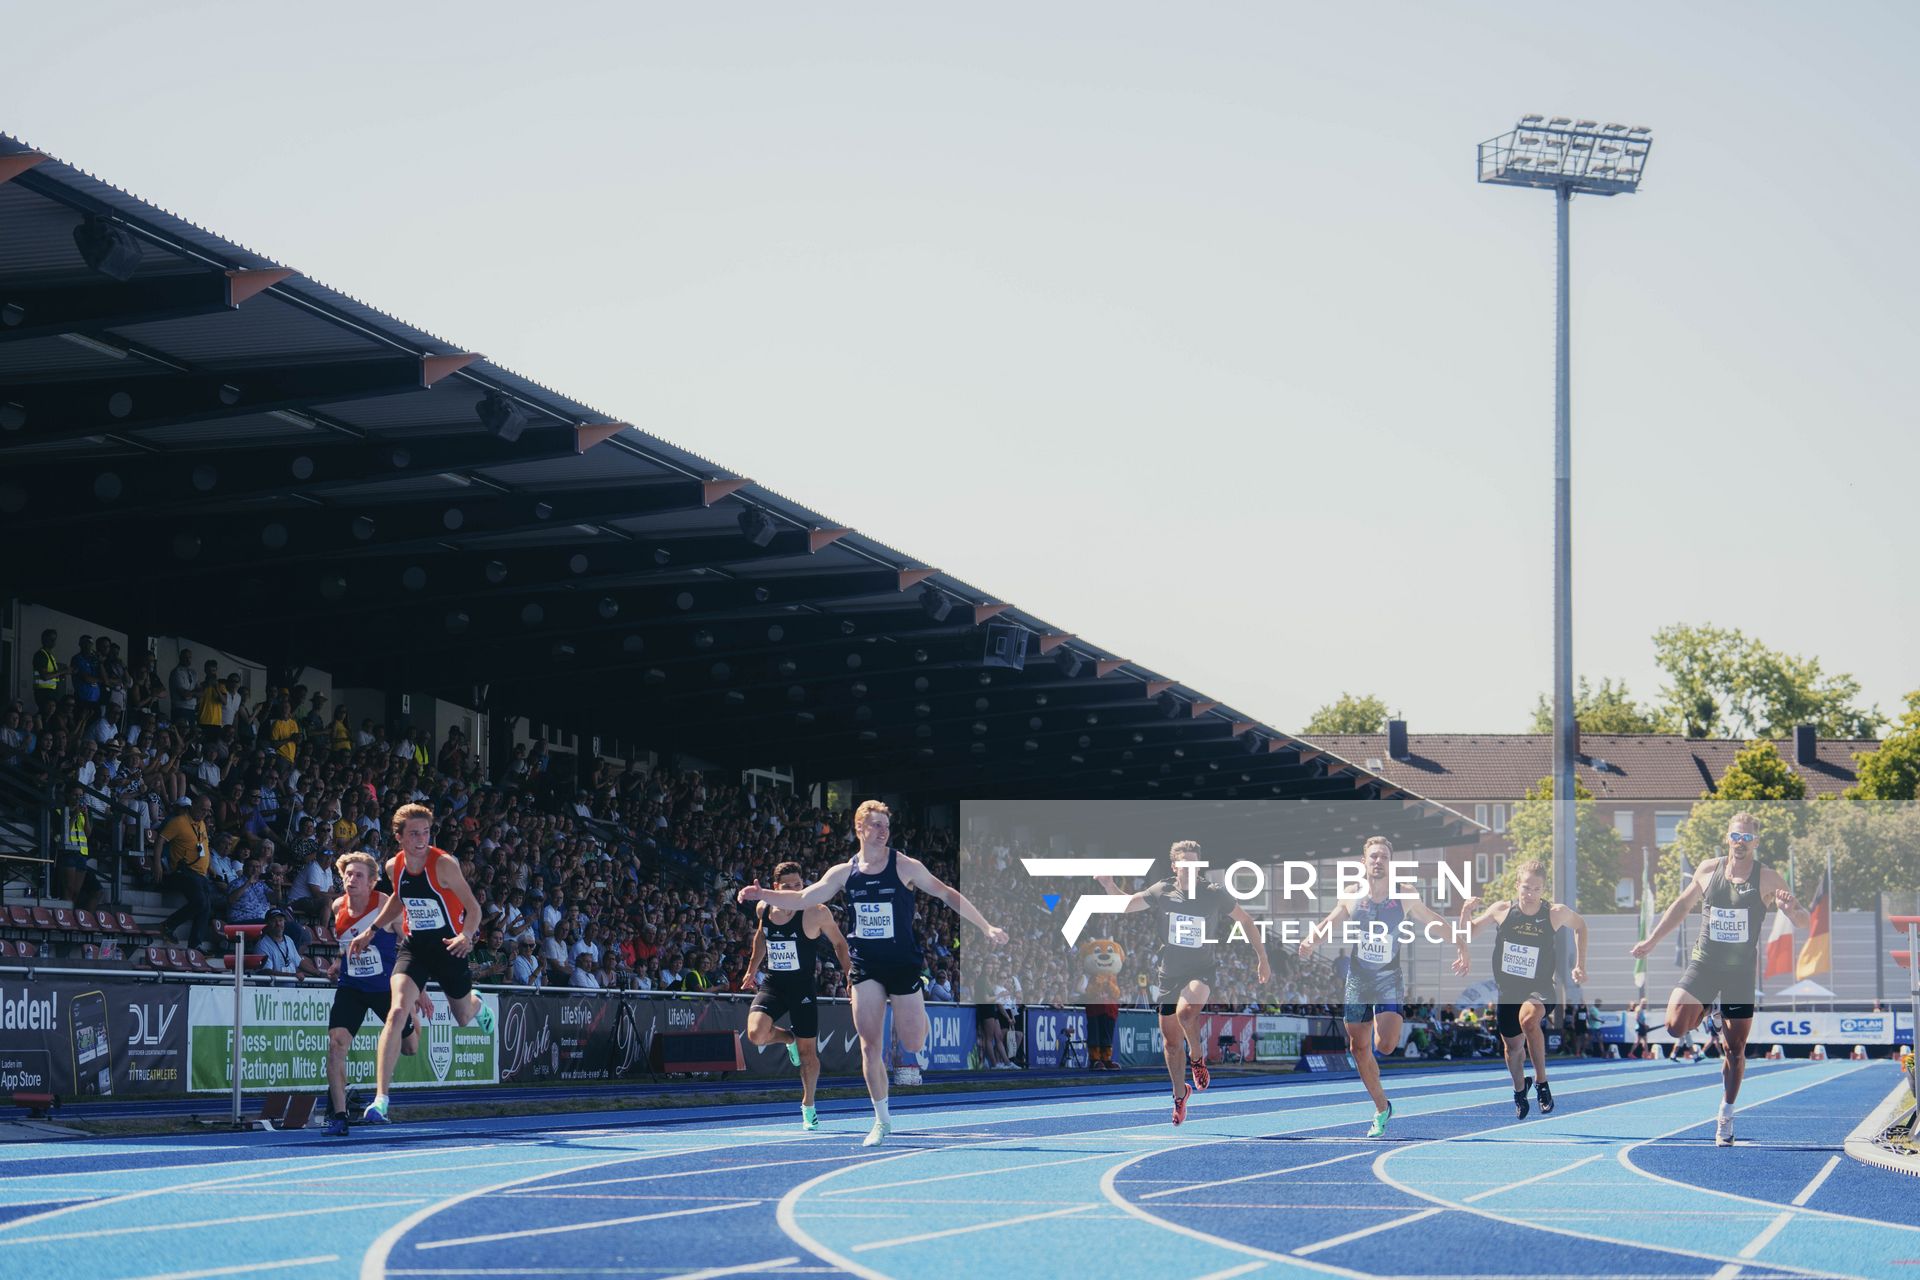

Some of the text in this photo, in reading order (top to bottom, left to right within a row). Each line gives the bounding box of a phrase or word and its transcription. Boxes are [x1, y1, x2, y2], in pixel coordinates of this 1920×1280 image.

[860, 904, 880, 912] GLS
[1717, 910, 1736, 918] GLS
[858, 915, 890, 926] THELANDER
[1711, 920, 1746, 931] HELCELET
[771, 942, 785, 950] GLS
[1361, 942, 1387, 953] KAUL
[1510, 945, 1529, 954] GLS
[768, 952, 796, 960] NOWAK
[254, 994, 278, 1020] Wir
[561, 1006, 592, 1028] LifeStyle
[128, 1004, 178, 1045] DLV
[1770, 1021, 1812, 1036] GLS
[1857, 1020, 1882, 1028] PLAN
[934, 1017, 960, 1047] PLAN
[1036, 1015, 1056, 1051] GLS
[274, 1029, 294, 1052] und
[1, 1060, 15, 1069] Laden
[455, 1053, 484, 1065] ratingen
[241, 1058, 289, 1085] Ratingen
[292, 1057, 317, 1079] Mitte
[320, 1057, 328, 1078] &
[0, 1071, 42, 1090] App Store
